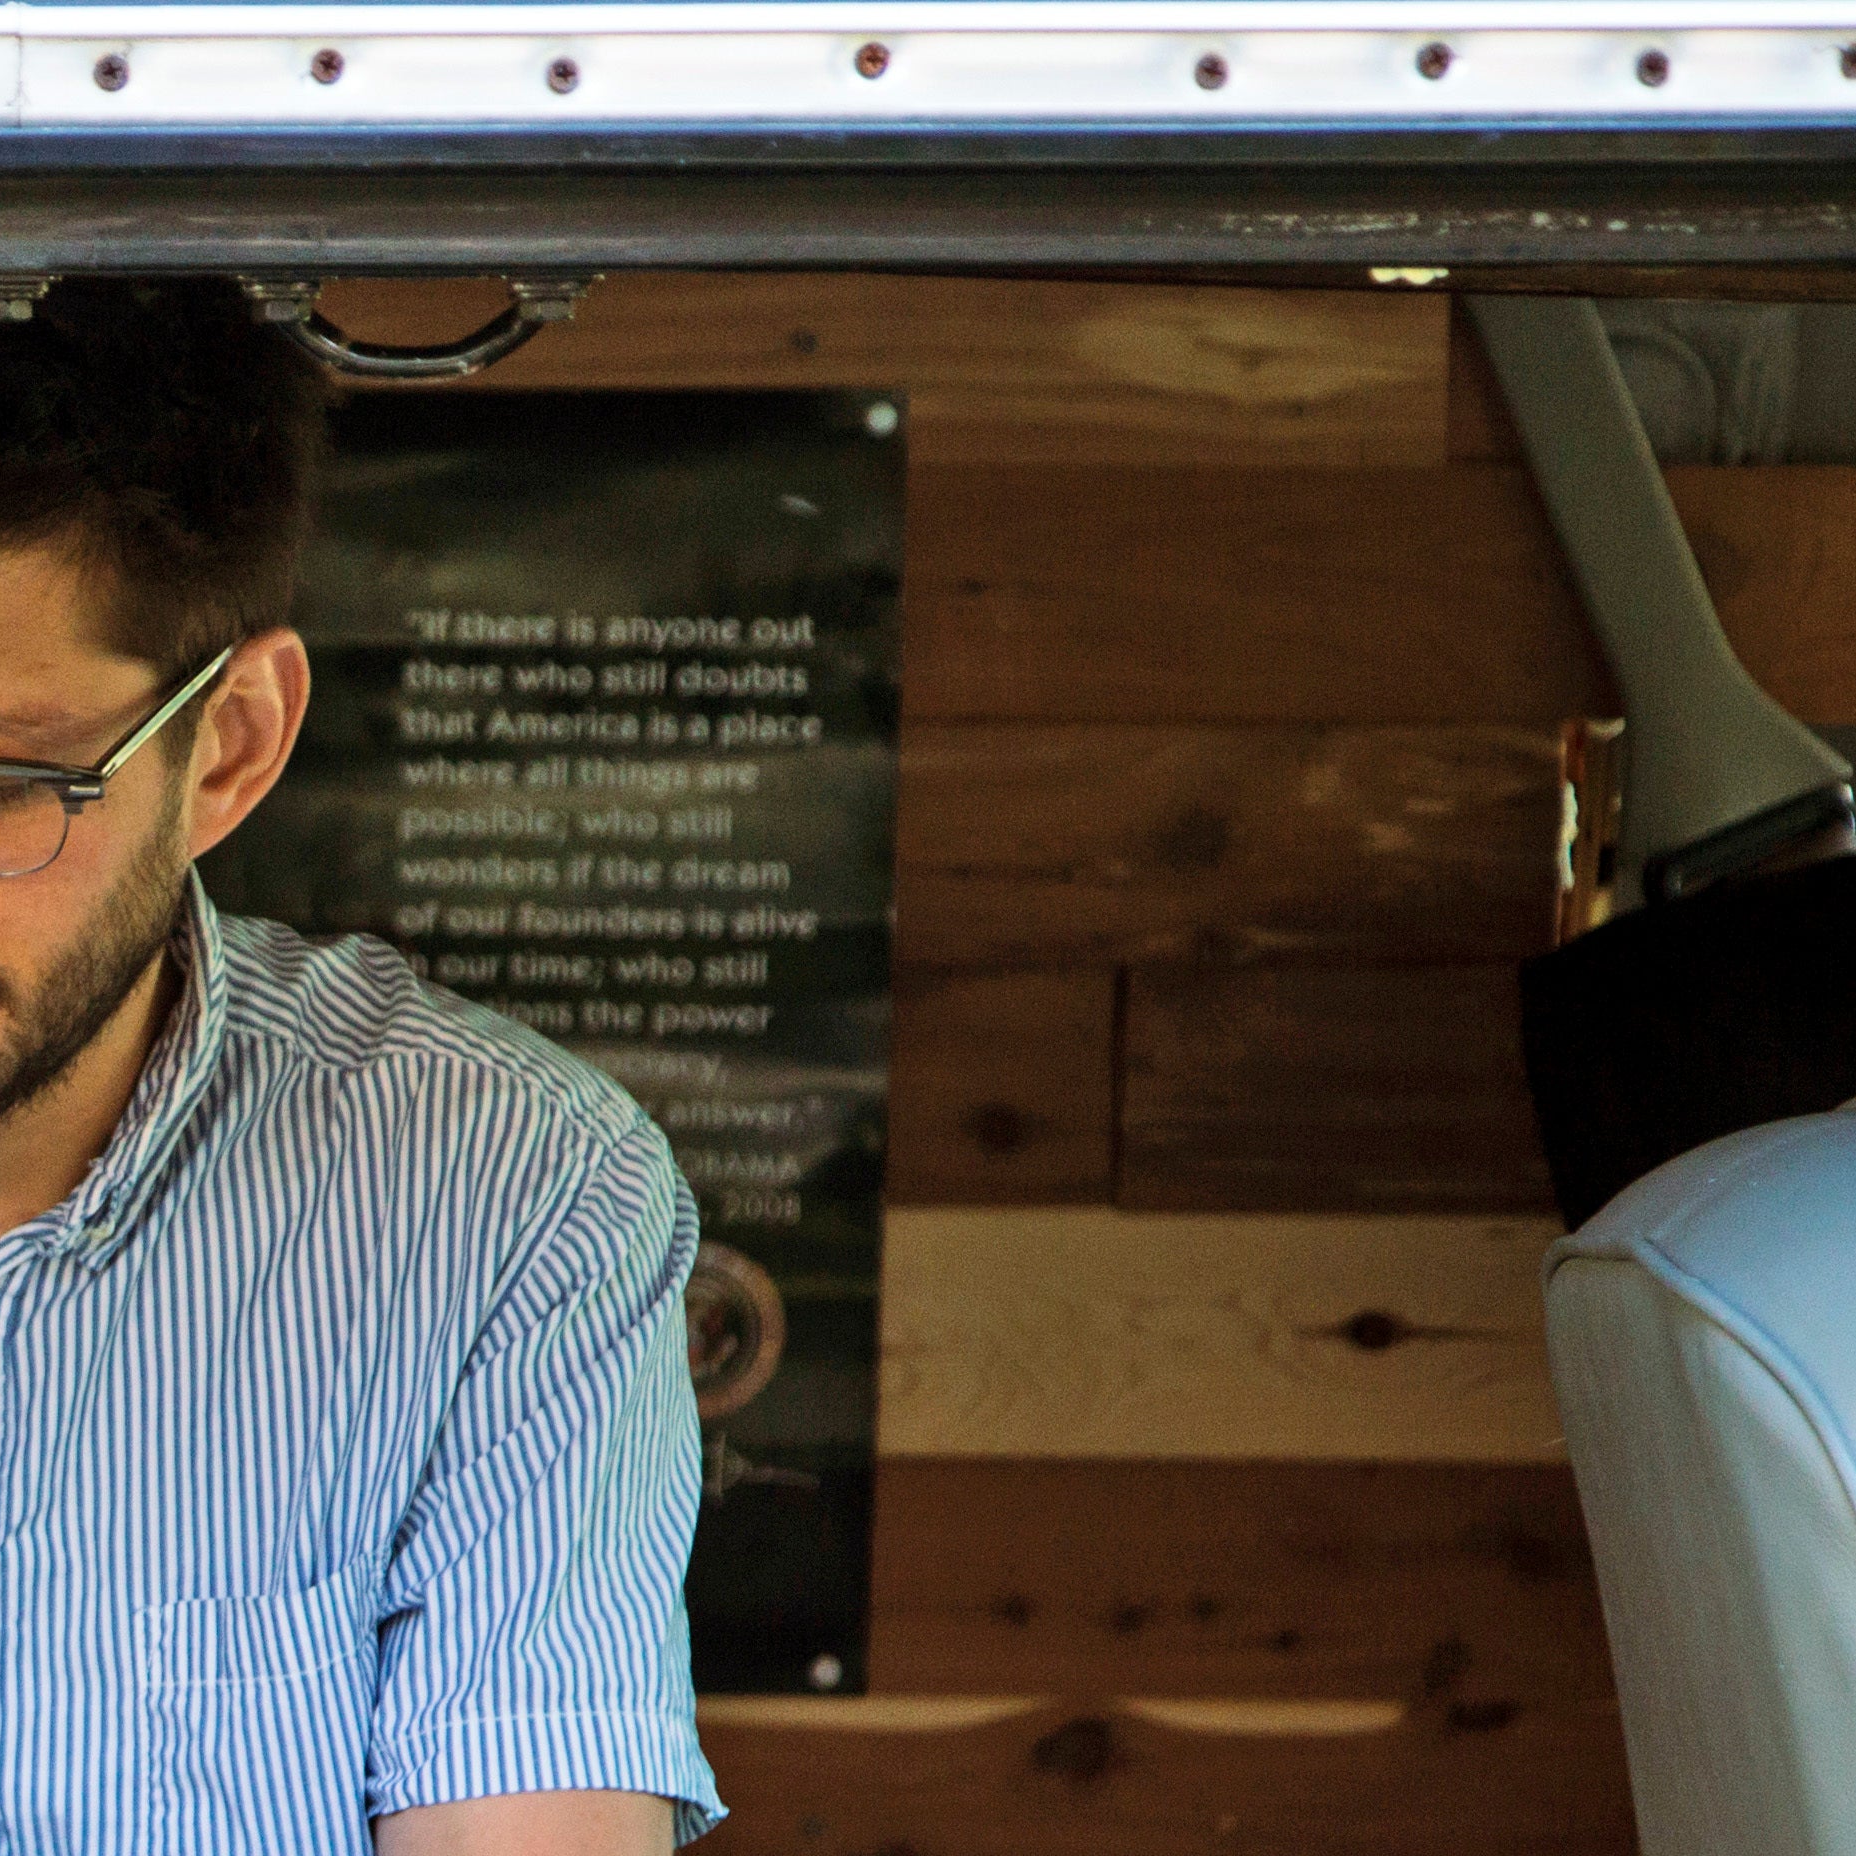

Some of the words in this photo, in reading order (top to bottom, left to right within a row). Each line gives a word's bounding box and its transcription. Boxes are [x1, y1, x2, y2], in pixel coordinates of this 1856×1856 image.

[454, 611, 558, 646] there
[566, 609, 595, 645] is
[603, 614, 742, 653] anyone
[749, 614, 816, 649] out
[402, 659, 504, 692] there
[514, 660, 593, 693] who
[599, 660, 668, 694] still
[676, 661, 809, 695] doubts
[399, 708, 477, 741] that
[487, 708, 640, 742] America
[648, 708, 680, 742] is
[687, 713, 711, 742] a
[717, 709, 823, 746] place
[401, 755, 515, 789] where
[524, 755, 569, 790] all
[578, 757, 691, 796] things
[699, 761, 761, 791] are
[580, 807, 661, 839] who
[667, 807, 734, 841] still
[400, 855, 560, 889] wonders
[567, 854, 594, 888] if
[599, 857, 663, 890] the
[671, 857, 792, 891] dream
[395, 903, 439, 936] of
[445, 907, 509, 937] our
[518, 904, 687, 938] founders
[695, 906, 725, 938] is
[731, 906, 820, 940] alive
[437, 951, 499, 982] our
[615, 952, 695, 984] who
[702, 952, 769, 987] still
[583, 1003, 644, 1032] the
[651, 1005, 775, 1038] power
